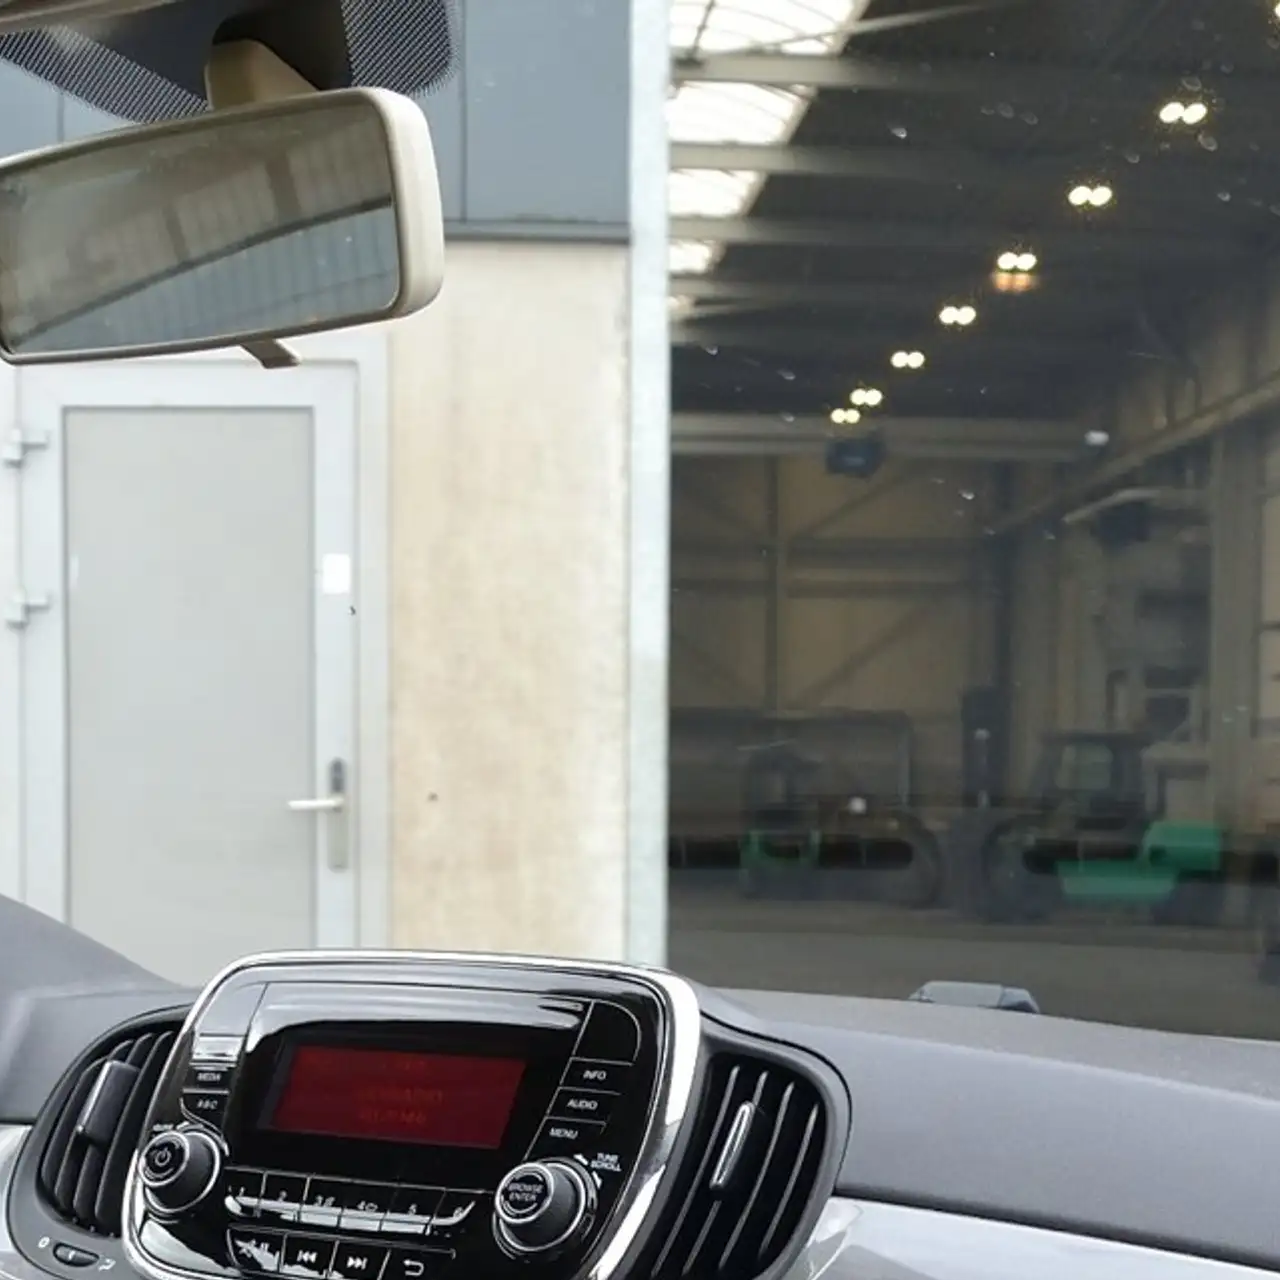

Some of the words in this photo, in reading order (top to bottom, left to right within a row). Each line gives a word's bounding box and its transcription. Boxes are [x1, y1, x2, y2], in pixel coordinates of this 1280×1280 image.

[583, 1070, 607, 1080] INFO
[567, 1099, 598, 1110] AUDIO
[549, 1127, 578, 1140] MENU
